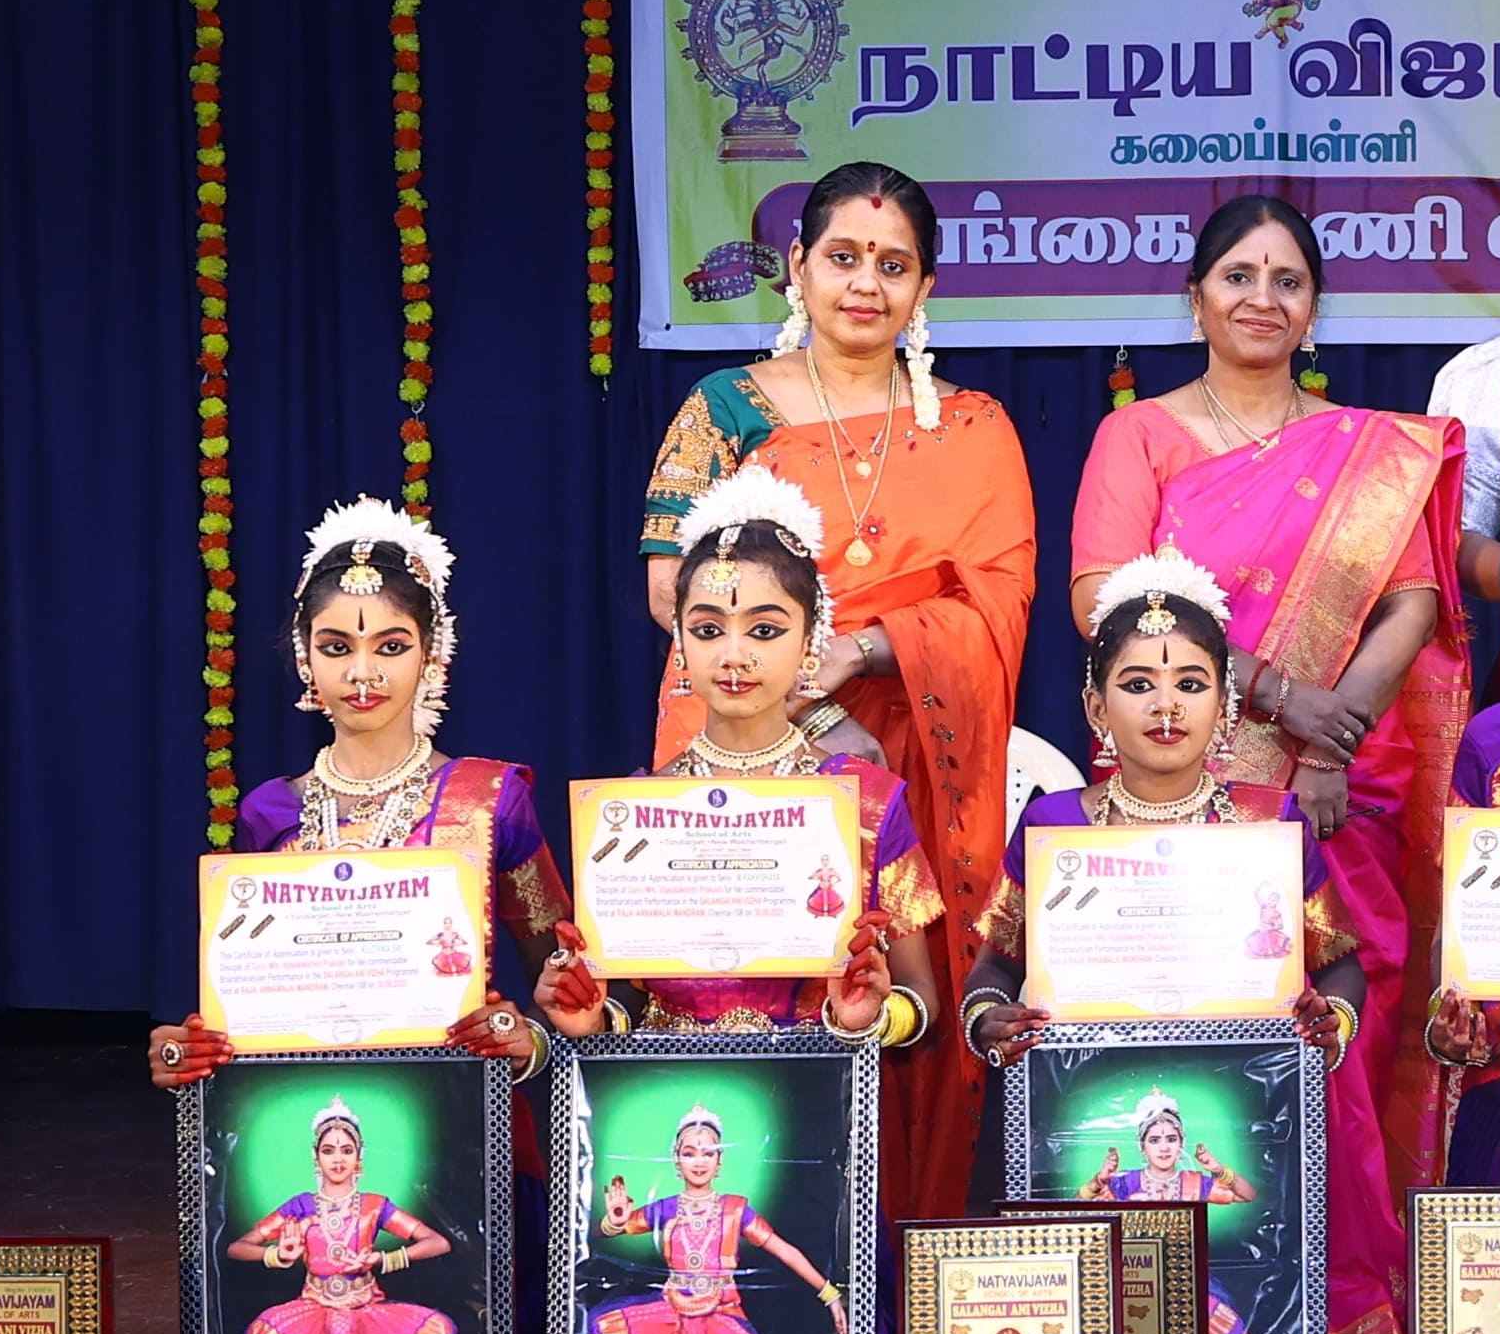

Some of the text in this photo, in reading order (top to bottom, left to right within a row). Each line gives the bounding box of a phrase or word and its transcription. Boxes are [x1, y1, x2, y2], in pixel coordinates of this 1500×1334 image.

[852, 29, 1253, 117] நாட்டிய
[1111, 116, 1417, 165] கலைப்பள்ளி
[635, 805, 805, 829] NATYAVIJAYAM
[262, 876, 430, 904] NATYAVIJAYAM
[978, 1273, 1067, 1288] NATYAVIJAYAM
[19, 1311, 40, 1319] ARTS
[953, 1304, 1007, 1317] SALANGAI
